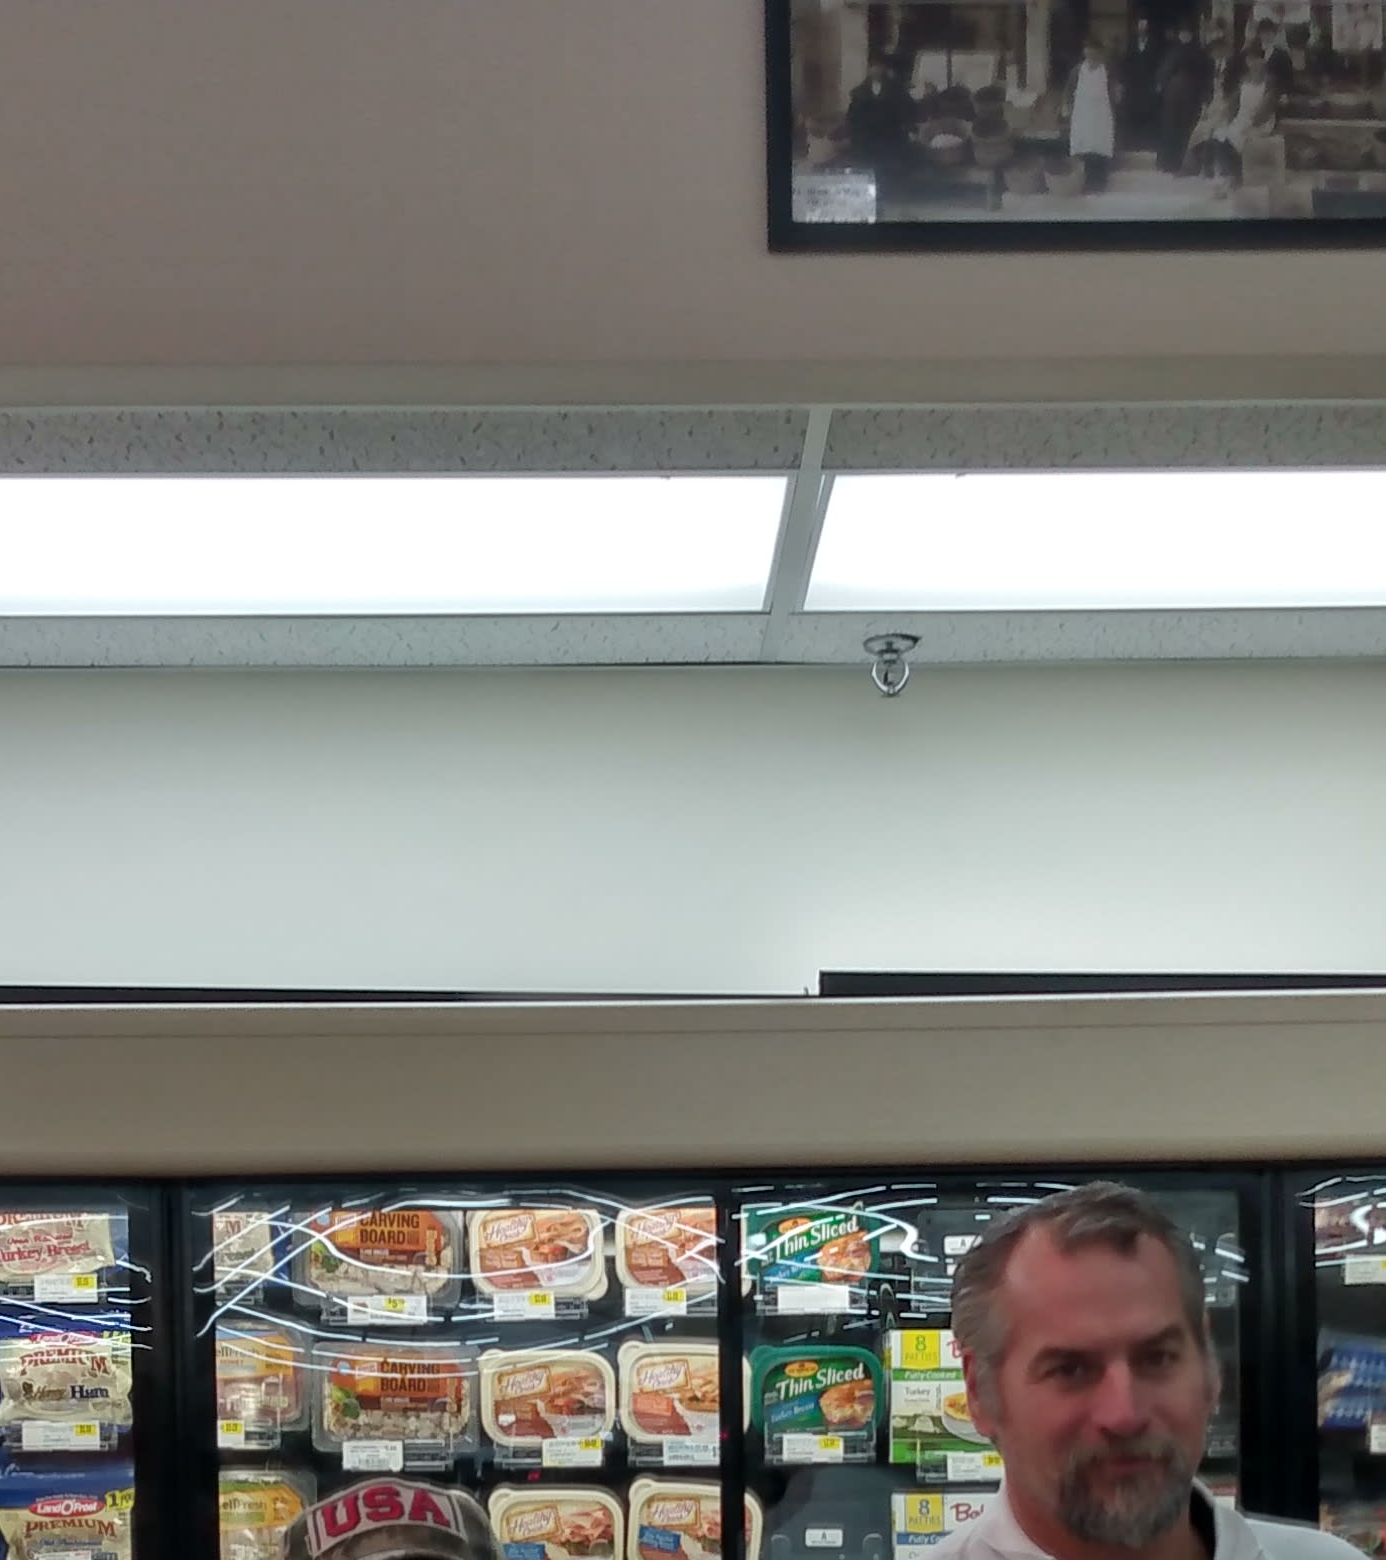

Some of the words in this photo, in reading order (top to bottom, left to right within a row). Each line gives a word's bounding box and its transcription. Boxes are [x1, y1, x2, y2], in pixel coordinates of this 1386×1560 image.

[360, 1212, 420, 1229] CARVING
[811, 1214, 860, 1243] Sliced
[359, 1228, 406, 1245] BOARD
[915, 1335, 927, 1351] 8
[380, 1376, 427, 1393] BOARD
[775, 1378, 814, 1401] Thin
[815, 1362, 865, 1388] Sliced
[70, 1385, 110, 1400] Ham
[320, 1483, 451, 1538] USA
[24, 1519, 117, 1538] PREMIUM
